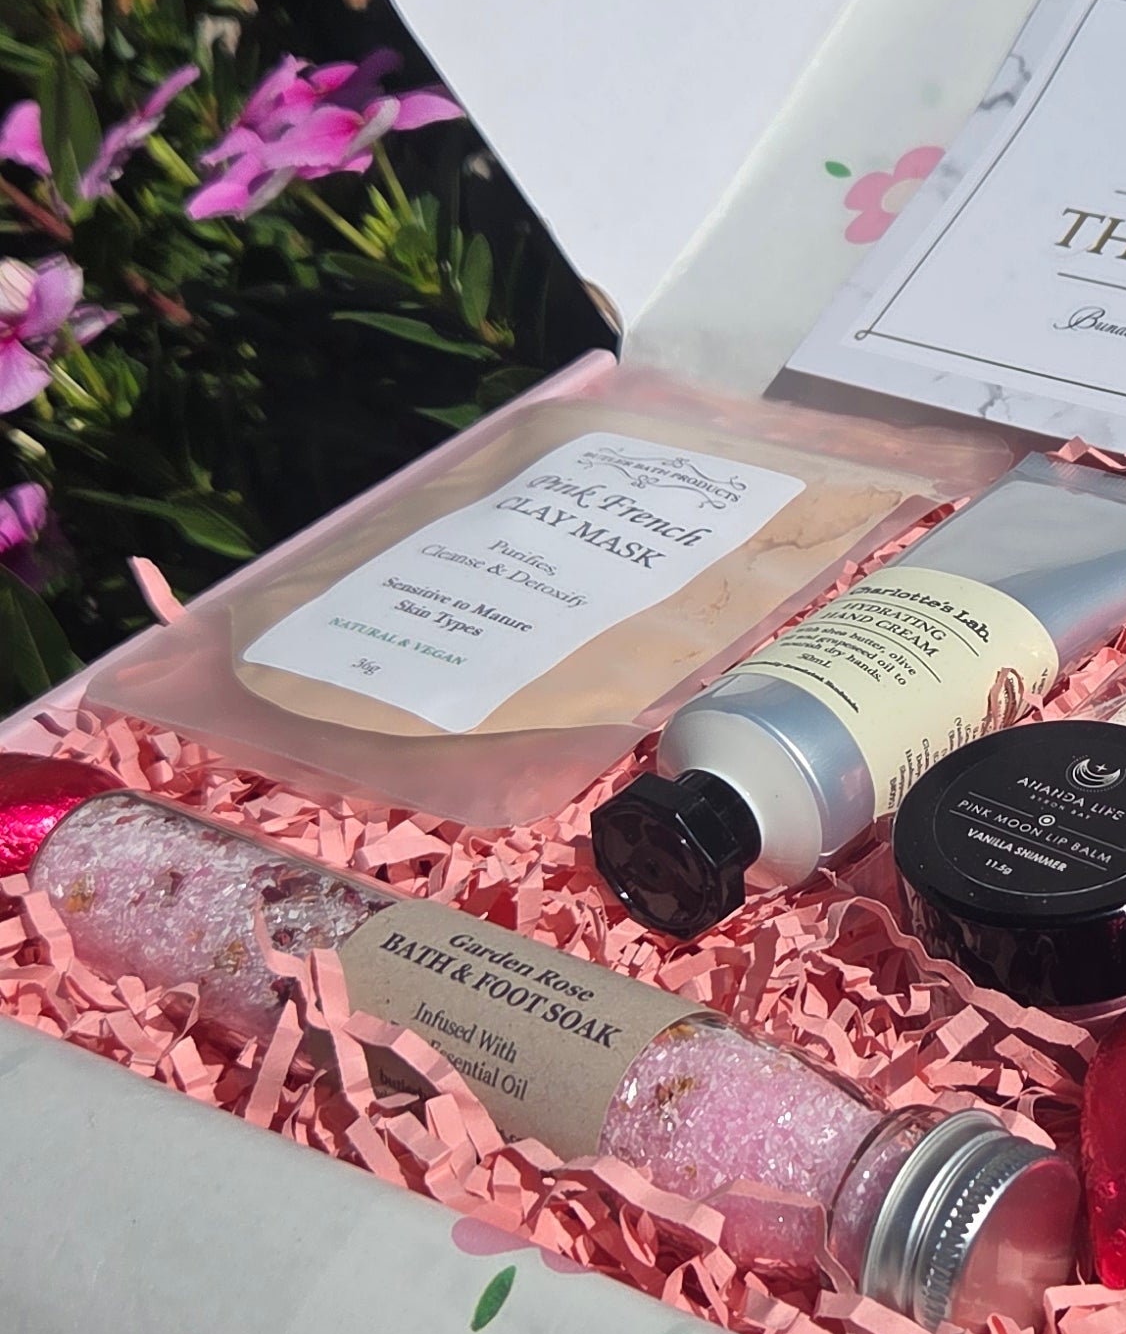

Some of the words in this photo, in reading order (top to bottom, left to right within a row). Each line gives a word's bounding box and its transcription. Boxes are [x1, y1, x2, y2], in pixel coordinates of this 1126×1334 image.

[634, 462, 671, 477] BATH
[669, 473, 741, 503] PRODUCTS
[496, 496, 577, 528] CLAY
[570, 520, 666, 569] MASK
[527, 474, 607, 508] Pink
[598, 493, 712, 547] French
[420, 543, 486, 569] Cleanse
[487, 563, 507, 576] &
[507, 569, 589, 609] Detoxify
[488, 539, 557, 576] Purifies,
[382, 576, 452, 604] Sensitive
[453, 596, 470, 611] to
[471, 603, 533, 633] Mature
[394, 599, 432, 619] Skin
[435, 611, 485, 638] Types
[842, 603, 947, 641] HYDRATING
[849, 586, 954, 614] Charlotte's
[328, 617, 398, 645] NATURAL
[397, 637, 410, 648] &
[413, 641, 470, 667] VEGAN
[821, 627, 848, 638] shea
[849, 632, 886, 654] butter,
[888, 650, 918, 676] olive
[824, 612, 874, 624] HAND
[875, 619, 940, 657] CREAM
[824, 647, 847, 658] dry
[816, 637, 877, 660] grapeseed
[877, 657, 895, 673] oil
[894, 672, 908, 686] to
[1017, 777, 1085, 807] ANANDA
[1091, 803, 1125, 820] LIFE
[957, 799, 992, 817] PINK
[994, 814, 1043, 837] MOON
[1045, 833, 1068, 845] LIP
[1070, 842, 1112, 864] BALM
[967, 828, 1014, 853] VANILLA
[1014, 847, 1069, 872] SHIMMER
[985, 858, 1013, 875] 11.5g
[380, 932, 455, 973] BATH
[450, 963, 475, 984] &
[471, 970, 549, 1014] FOOT
[541, 1003, 622, 1049] SOAK
[448, 933, 540, 980] Garden
[534, 968, 596, 1003] Rose
[413, 1001, 478, 1044] Infused
[478, 1033, 518, 1064] With
[501, 1074, 529, 1101] Oil
